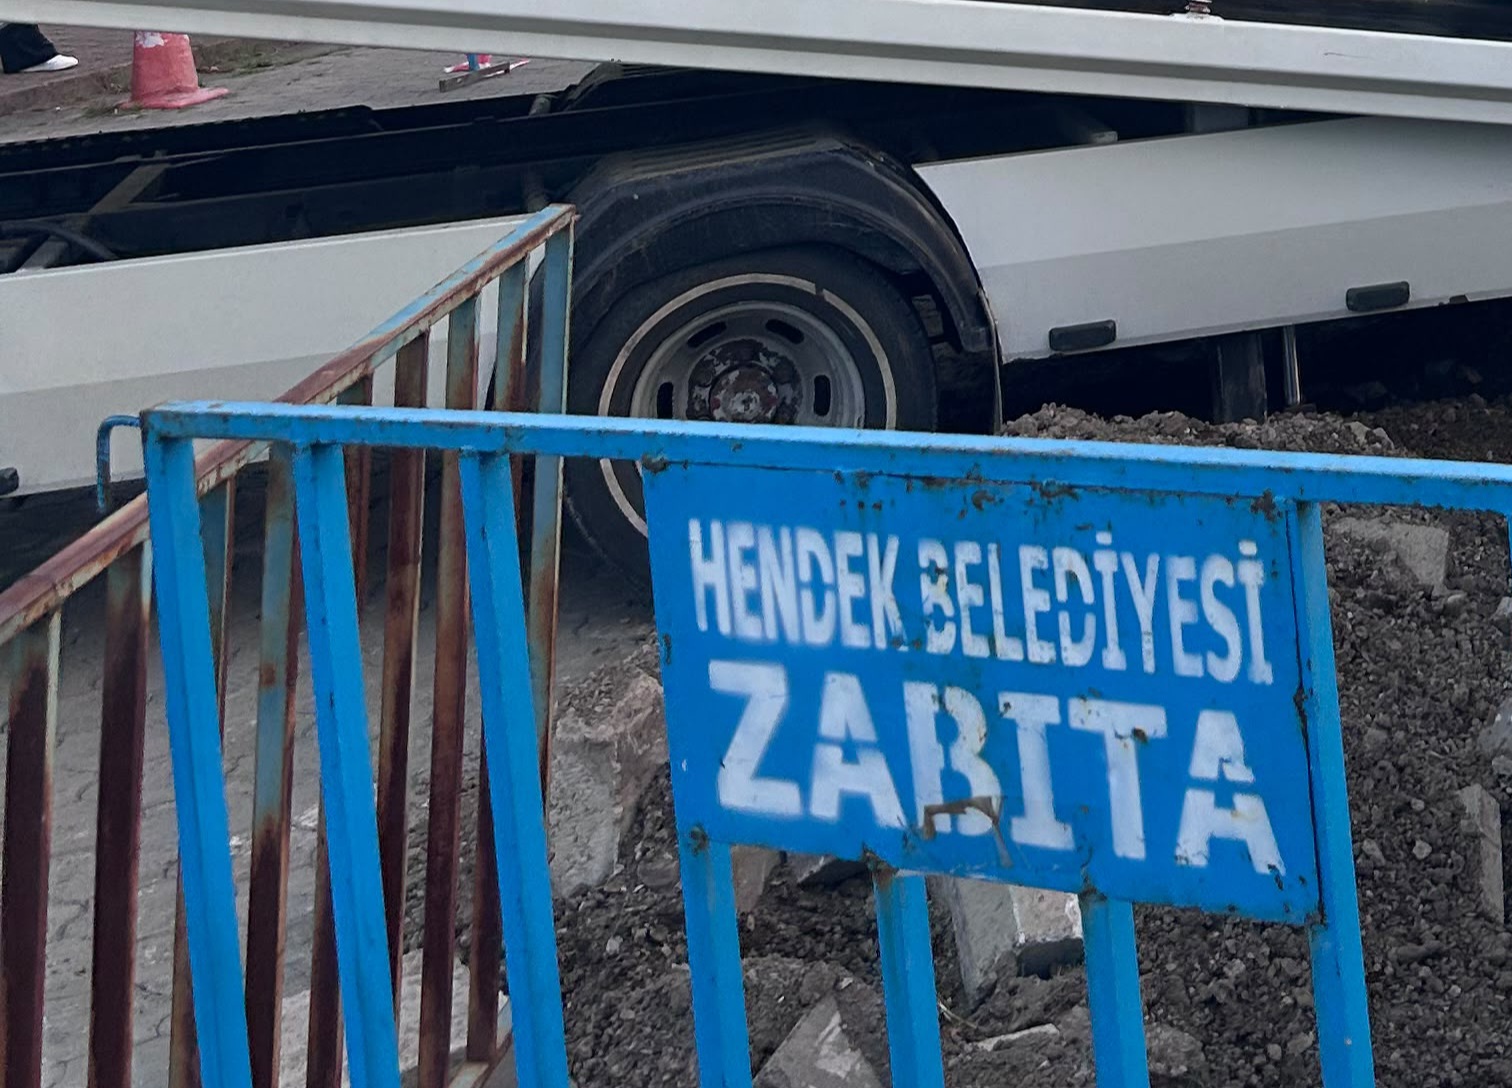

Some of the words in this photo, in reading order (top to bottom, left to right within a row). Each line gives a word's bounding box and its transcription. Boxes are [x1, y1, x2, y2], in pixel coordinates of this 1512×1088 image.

[688, 517, 909, 652] HENDEK
[917, 530, 1274, 685] BELEDİYESİ
[707, 659, 1287, 877] ZABITA
